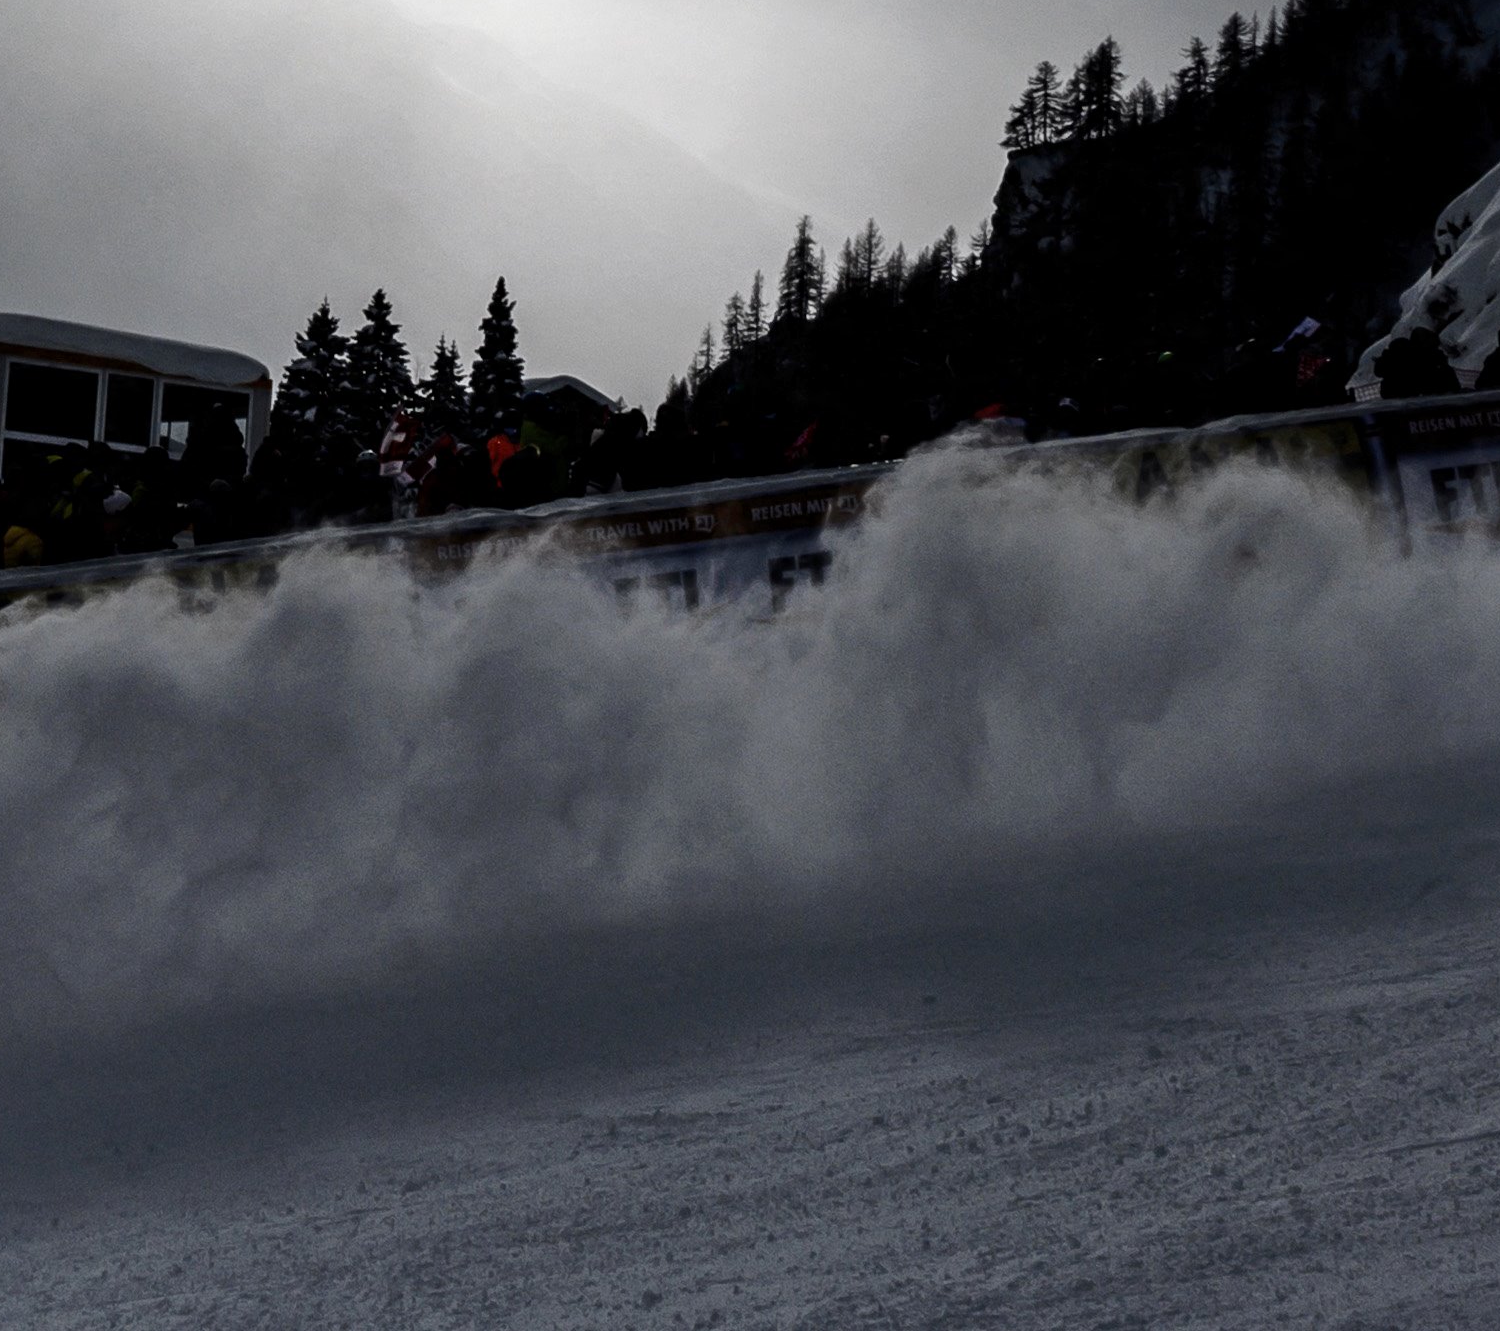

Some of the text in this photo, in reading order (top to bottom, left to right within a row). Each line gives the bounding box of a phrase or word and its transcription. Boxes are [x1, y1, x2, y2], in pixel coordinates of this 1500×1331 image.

[1409, 414, 1456, 434] REISEN
[1457, 411, 1484, 427] MIT
[751, 498, 802, 522] REISEN
[806, 496, 832, 514] MIT
[585, 519, 643, 541] TRAVEL
[648, 517, 690, 535] WITH
[769, 550, 832, 612] FT
